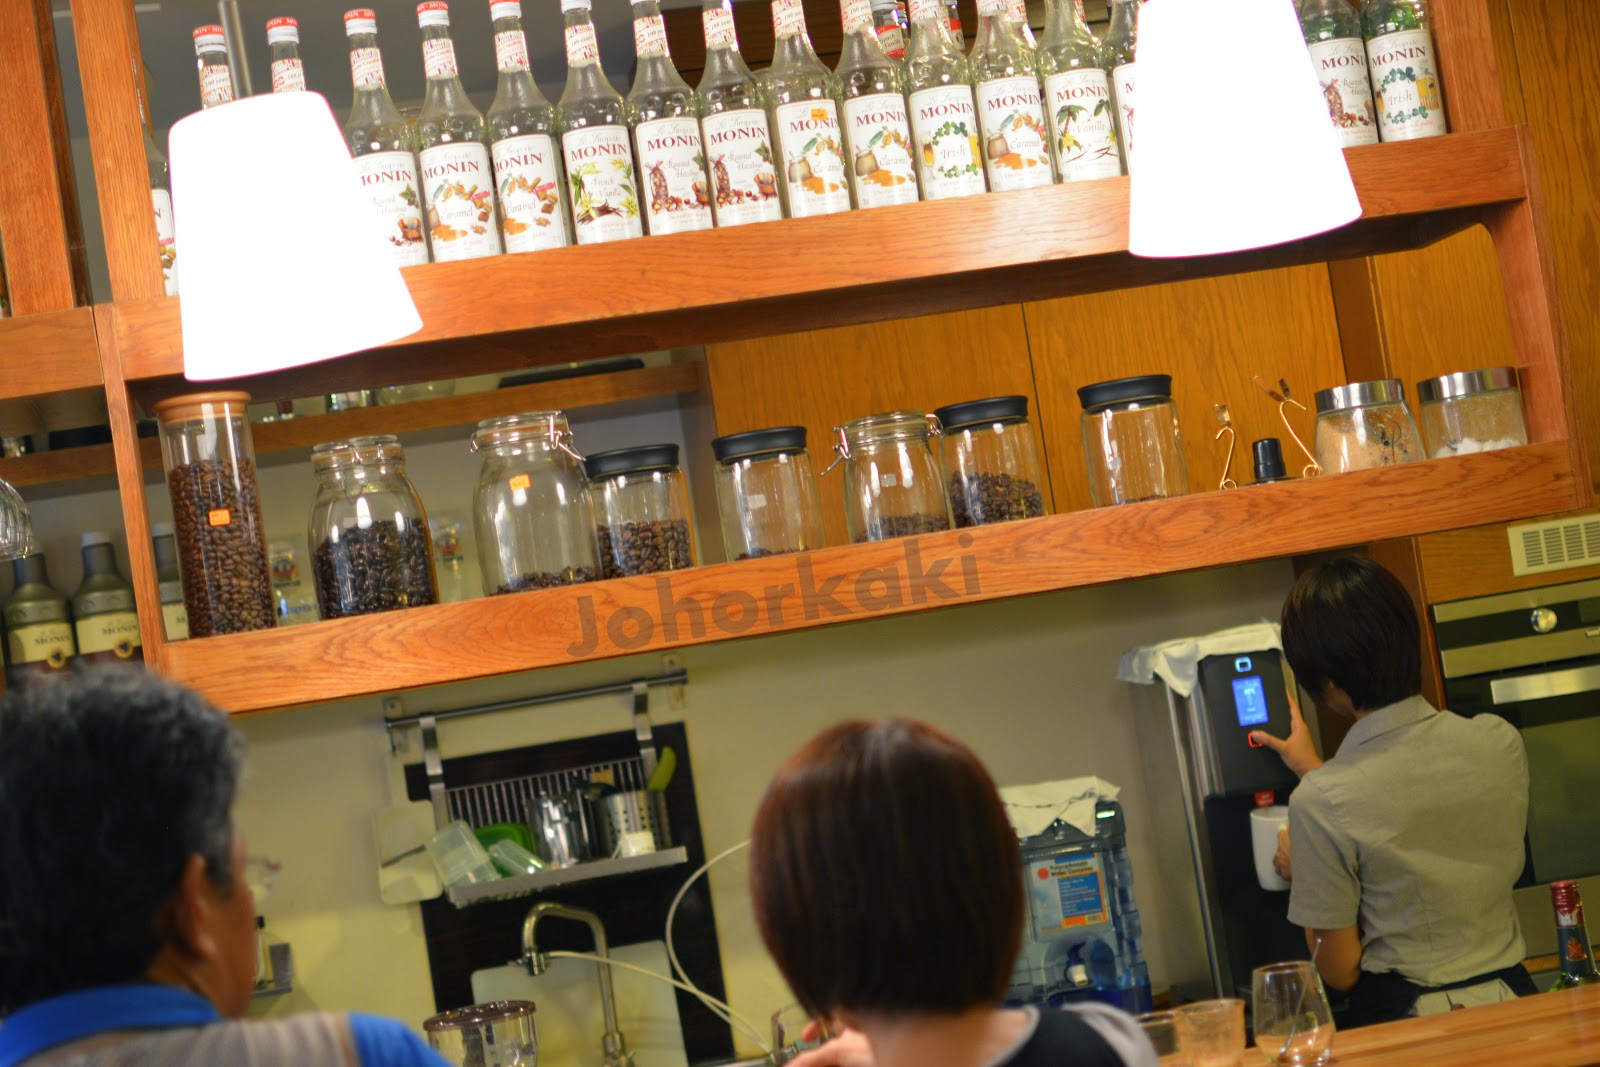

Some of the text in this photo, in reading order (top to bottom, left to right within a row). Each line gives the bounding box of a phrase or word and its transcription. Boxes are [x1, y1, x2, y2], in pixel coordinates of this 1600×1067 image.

[1372, 46, 1427, 69] MONIN
[987, 94, 1040, 111] MONIN
[1056, 85, 1109, 103] MONIN
[856, 111, 908, 127] MONIN
[920, 103, 973, 120] MONIN
[647, 135, 701, 152] MONIN
[710, 127, 766, 146] MONIN
[571, 143, 628, 162] MONIN
[424, 161, 479, 181] MONIN
[440, 206, 474, 221] Caramel
